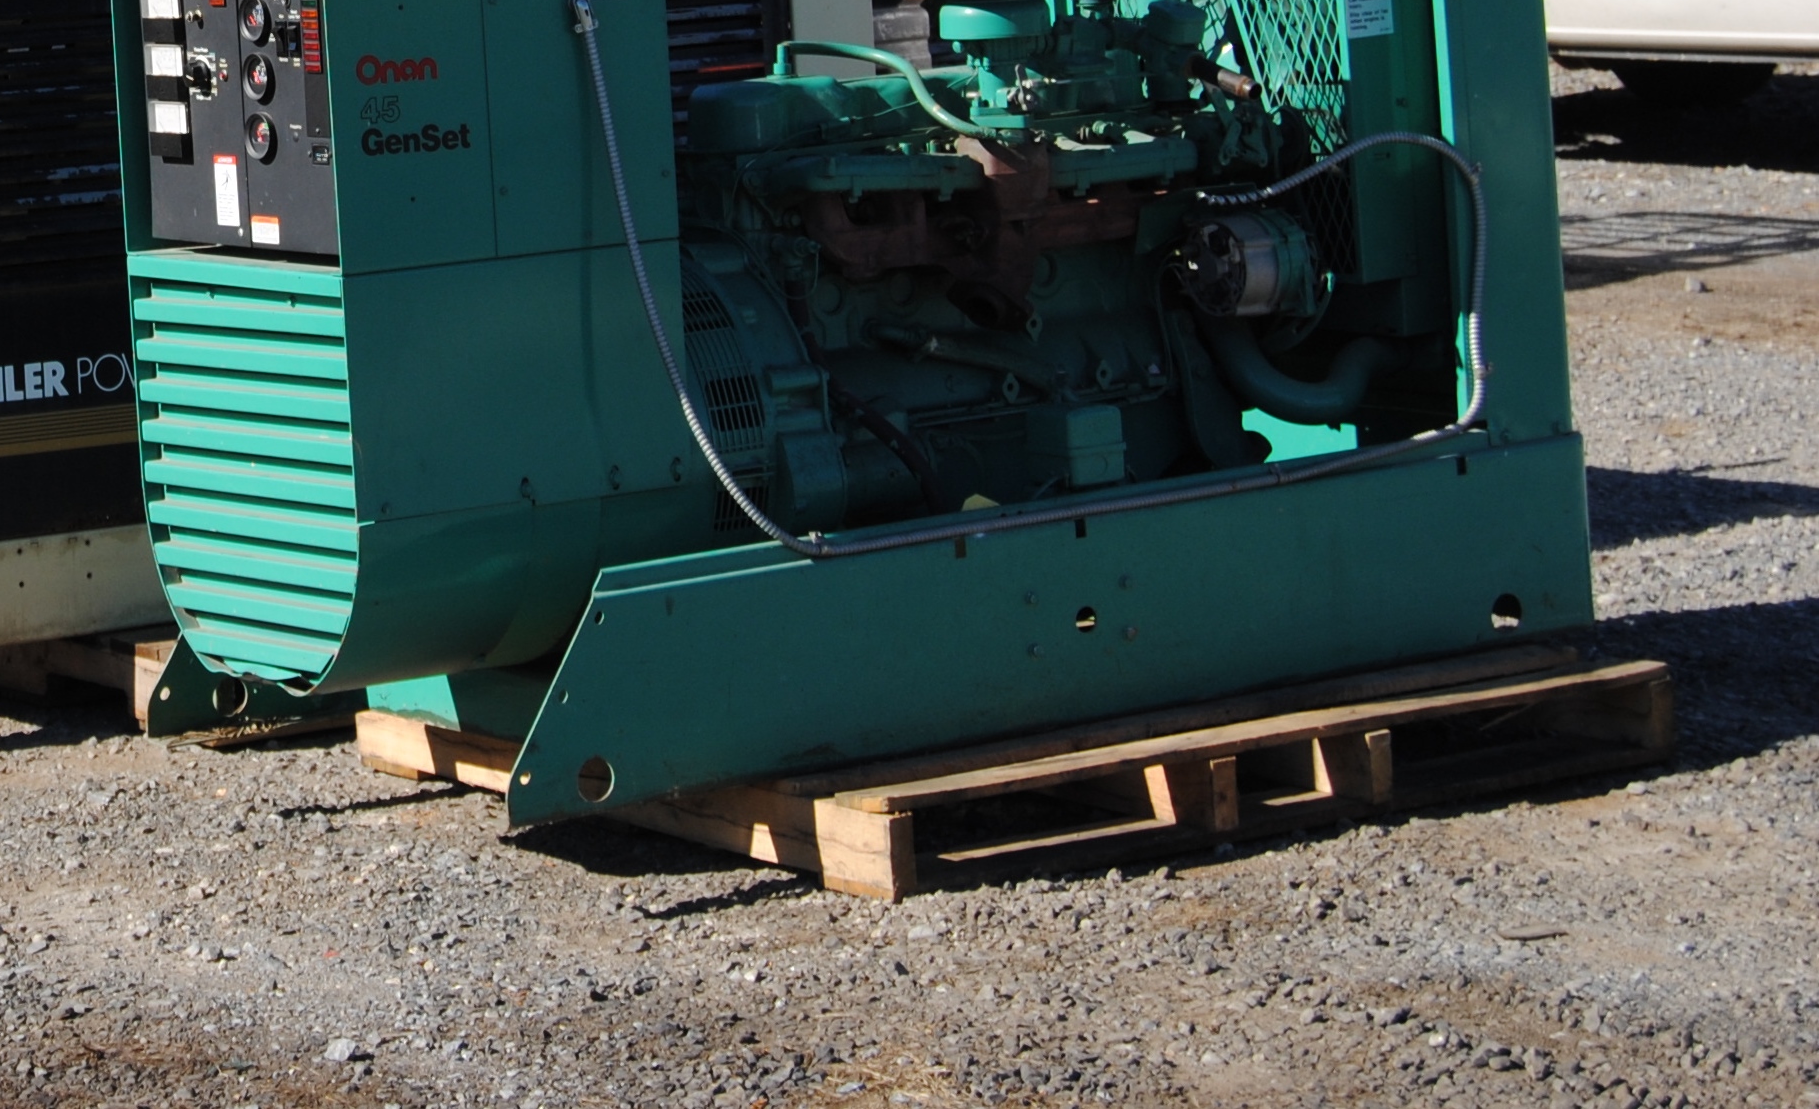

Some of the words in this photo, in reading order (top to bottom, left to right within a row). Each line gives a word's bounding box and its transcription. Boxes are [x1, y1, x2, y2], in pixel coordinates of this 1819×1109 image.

[355, 54, 438, 86] Onan
[360, 94, 401, 124] 45
[361, 123, 471, 156] GenSet
